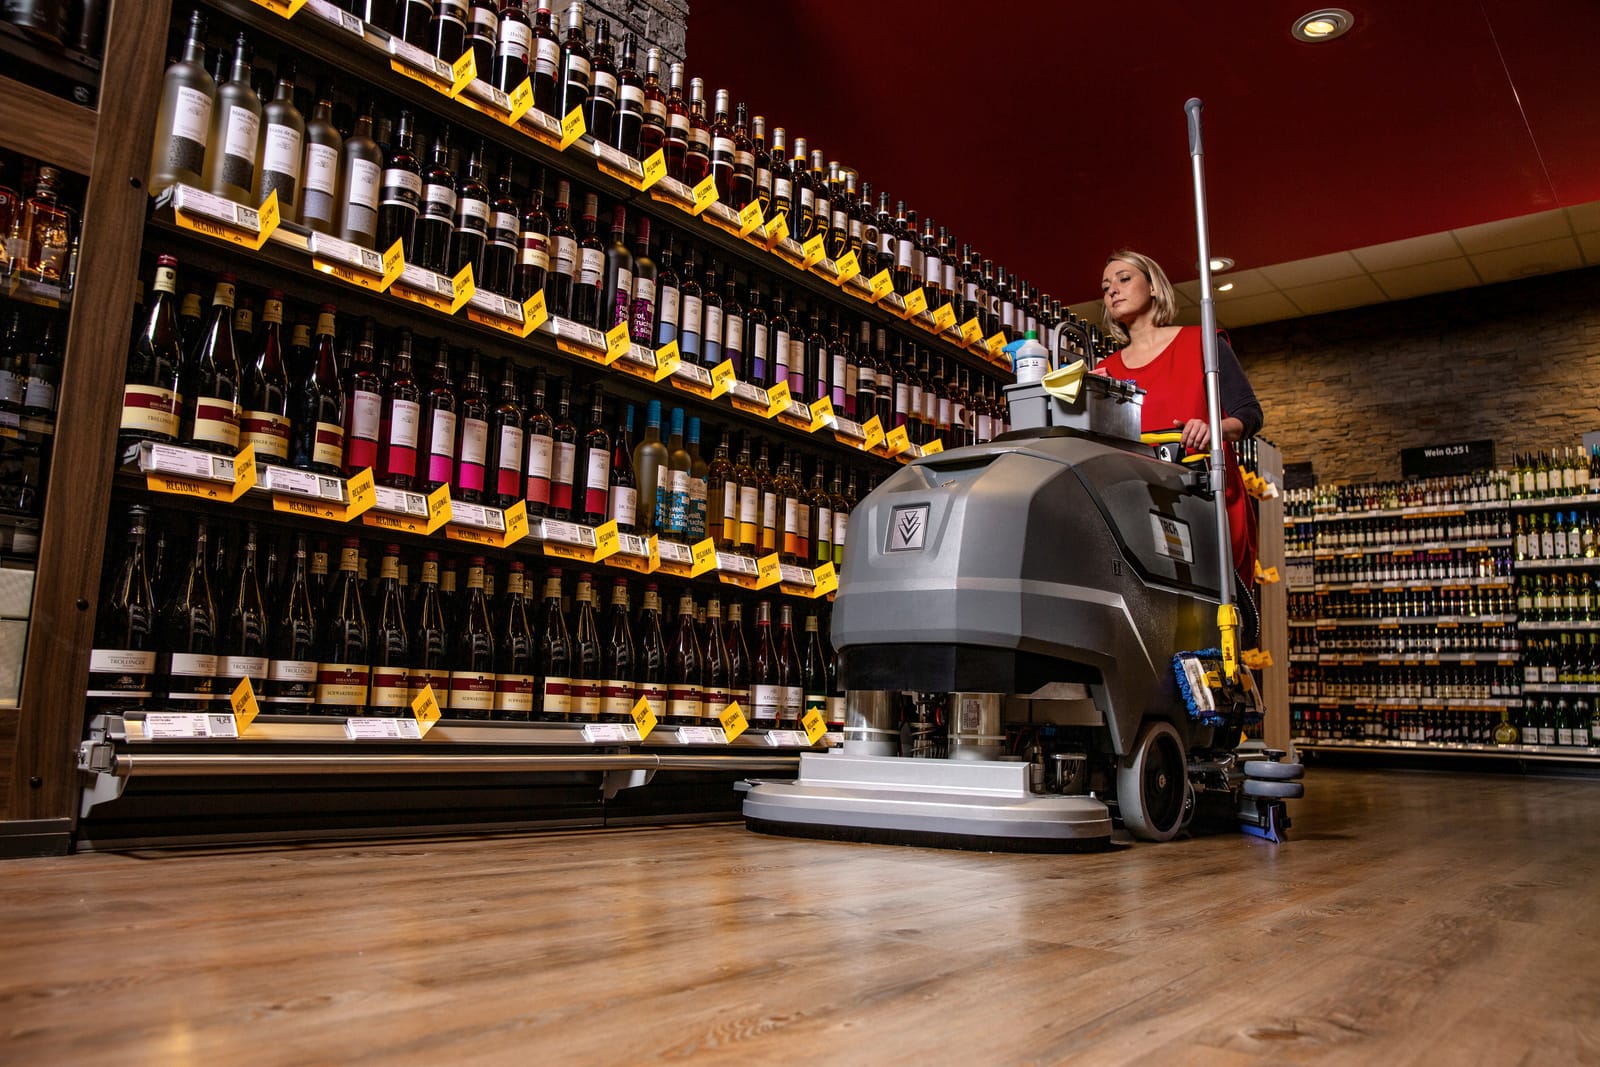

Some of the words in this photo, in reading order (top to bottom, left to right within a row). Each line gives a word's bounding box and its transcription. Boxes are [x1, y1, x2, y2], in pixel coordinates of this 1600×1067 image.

[192, 219, 225, 236] REGIONAL
[1424, 448, 1444, 457] Wein
[1445, 446, 1464, 456] 0,25
[166, 480, 200, 494] REGIONAL
[352, 480, 371, 497] REGIONAL
[289, 501, 318, 515] REGIONAL
[431, 496, 447, 512] REGIONAL
[376, 515, 402, 528] REGIONAL
[509, 512, 524, 527] REGIONAL
[599, 530, 615, 542] REGIONAL
[696, 548, 712, 559] REGIONAL
